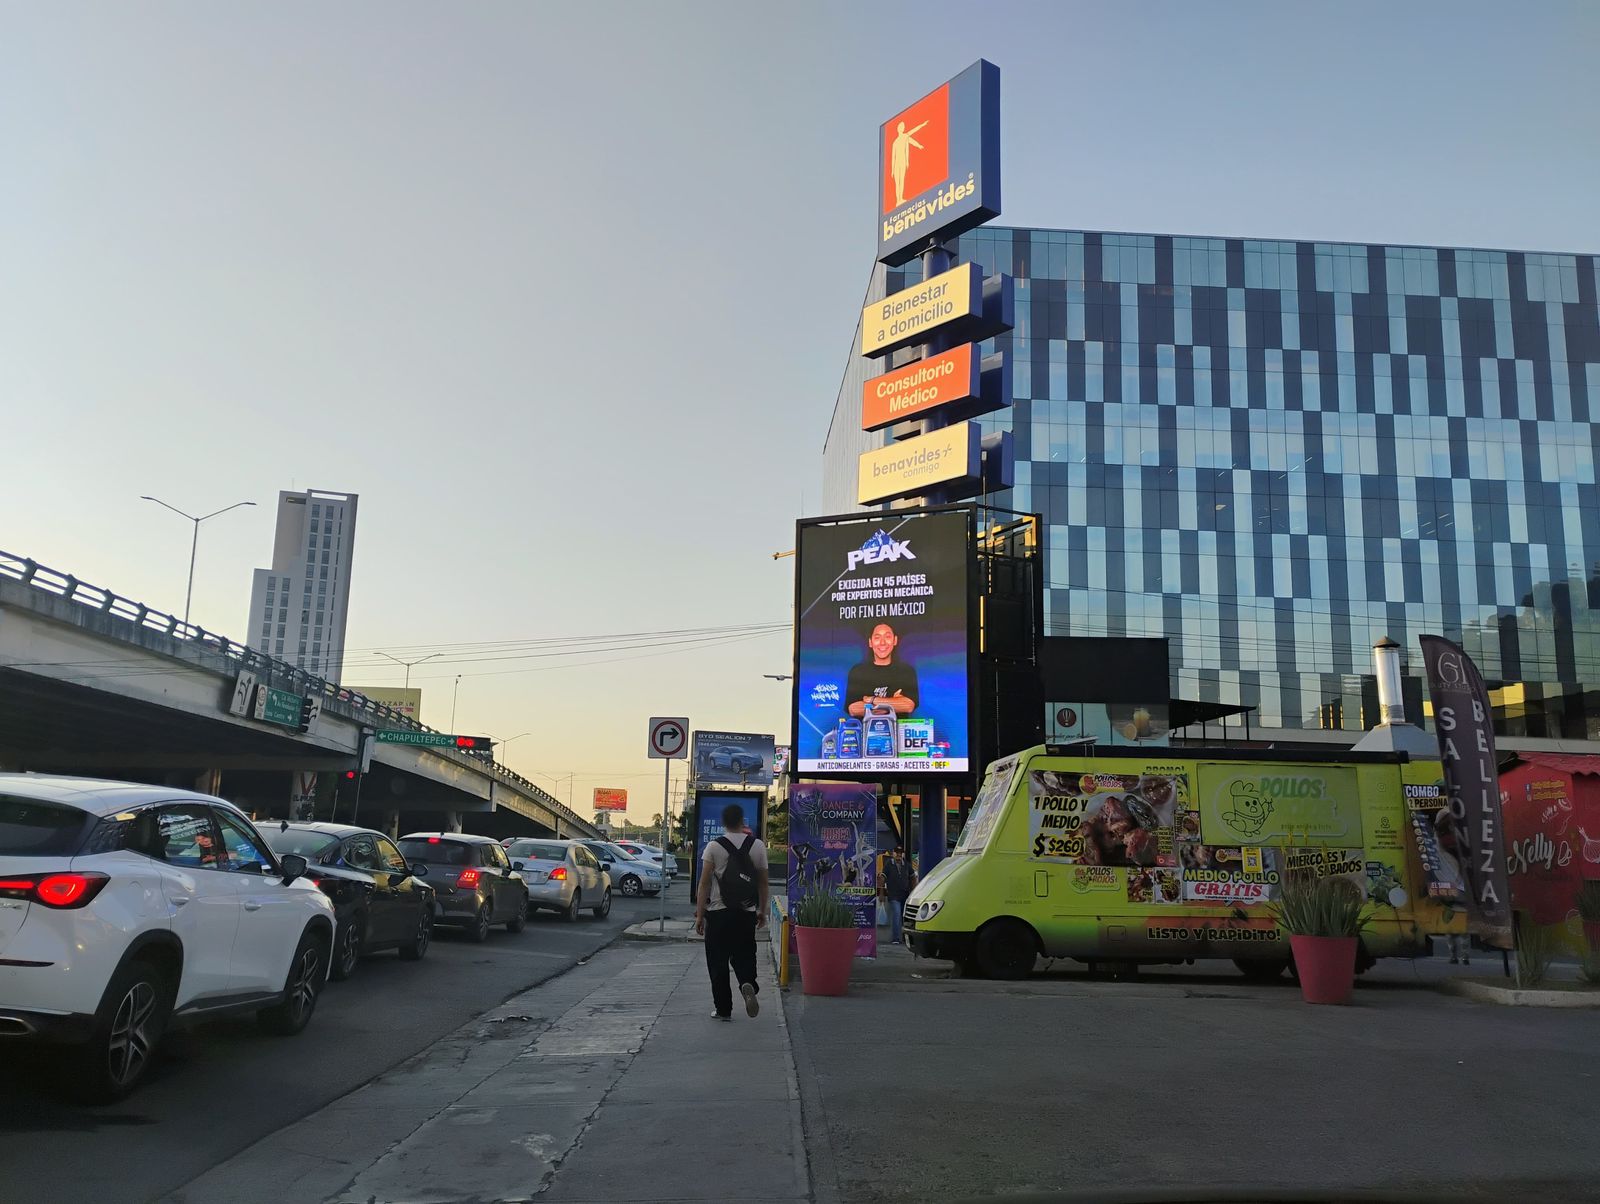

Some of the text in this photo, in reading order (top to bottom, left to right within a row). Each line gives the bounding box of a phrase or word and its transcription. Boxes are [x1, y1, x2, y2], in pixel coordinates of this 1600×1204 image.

[883, 178, 975, 241] benavides
[889, 200, 926, 224] farmacias
[882, 282, 948, 320] Bienestar
[877, 301, 953, 342] a domicilio
[876, 360, 954, 398] Consultorio
[889, 386, 938, 413] Médico
[873, 448, 941, 478] benavides
[902, 461, 940, 478] conmigo
[847, 540, 917, 571] PEAK
[838, 572, 926, 591] EXIGIDA EN 45 PAÍSES
[831, 584, 934, 602] POR EXPERTOS EN MECÁNICA
[839, 600, 925, 620] POR FIN EN MÉXICO
[387, 732, 447, 745] CHAPULTEPEC
[904, 728, 928, 738] Blue
[904, 738, 926, 749] DEF
[817, 761, 946, 770] ANTICONGELANTES GRASAS ACEITES DEF
[1259, 777, 1323, 799] POLLOS
[1405, 785, 1439, 798] COMBO
[822, 801, 854, 811] DANCE
[1034, 796, 1089, 812] 1 POLLO Y
[1472, 698, 1500, 903] BELLEZA
[821, 810, 865, 819] COMPANY
[1041, 814, 1080, 829] MEDIO
[1048, 837, 1081, 853] $260
[1340, 850, 1347, 861] Y
[1507, 832, 1556, 875] Nelly
[1087, 867, 1112, 876] POLLOS
[1184, 868, 1280, 884] MEDIO POLLO
[1194, 882, 1263, 897] GRATIS
[1192, 928, 1204, 940] Y
